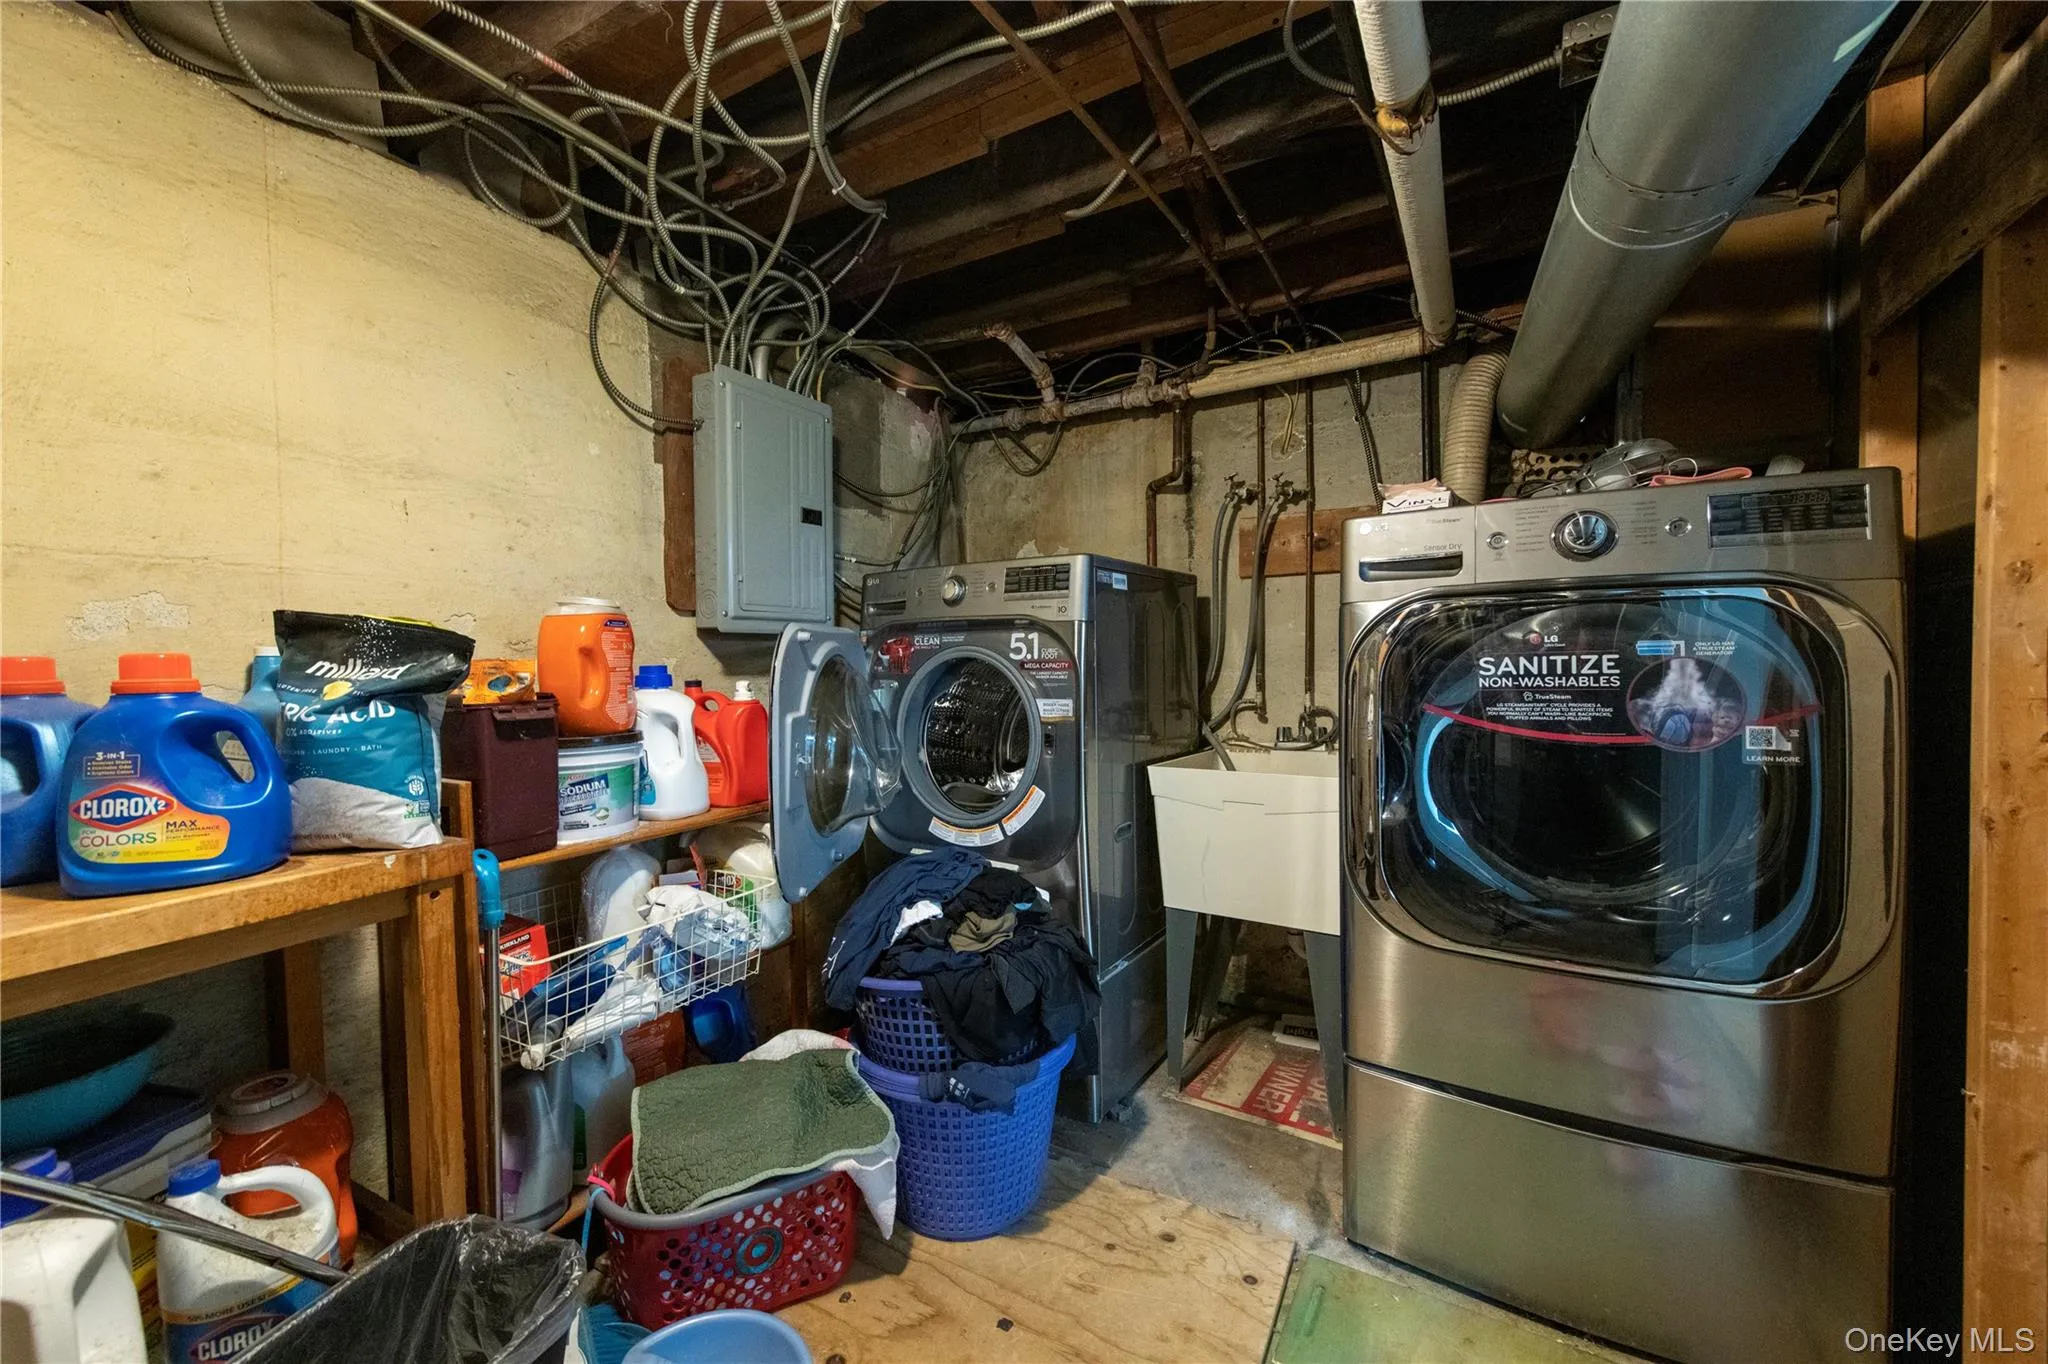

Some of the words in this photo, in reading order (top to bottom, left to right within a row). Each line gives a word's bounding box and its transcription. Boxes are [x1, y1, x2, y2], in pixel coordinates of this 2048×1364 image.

[914, 637, 940, 645] CLEAN
[1544, 635, 1559, 643] LG
[1009, 632, 1039, 660] 5.1
[1479, 654, 1621, 676] SANITIZE
[1479, 676, 1621, 688] NON-WASHABLES
[327, 700, 396, 724] ACID
[95, 751, 126, 761] 3-IN-1
[312, 747, 350, 755] LAUNDRY
[560, 779, 606, 798] SODIUM
[166, 820, 197, 830] MAX
[79, 832, 157, 848] COLORS
